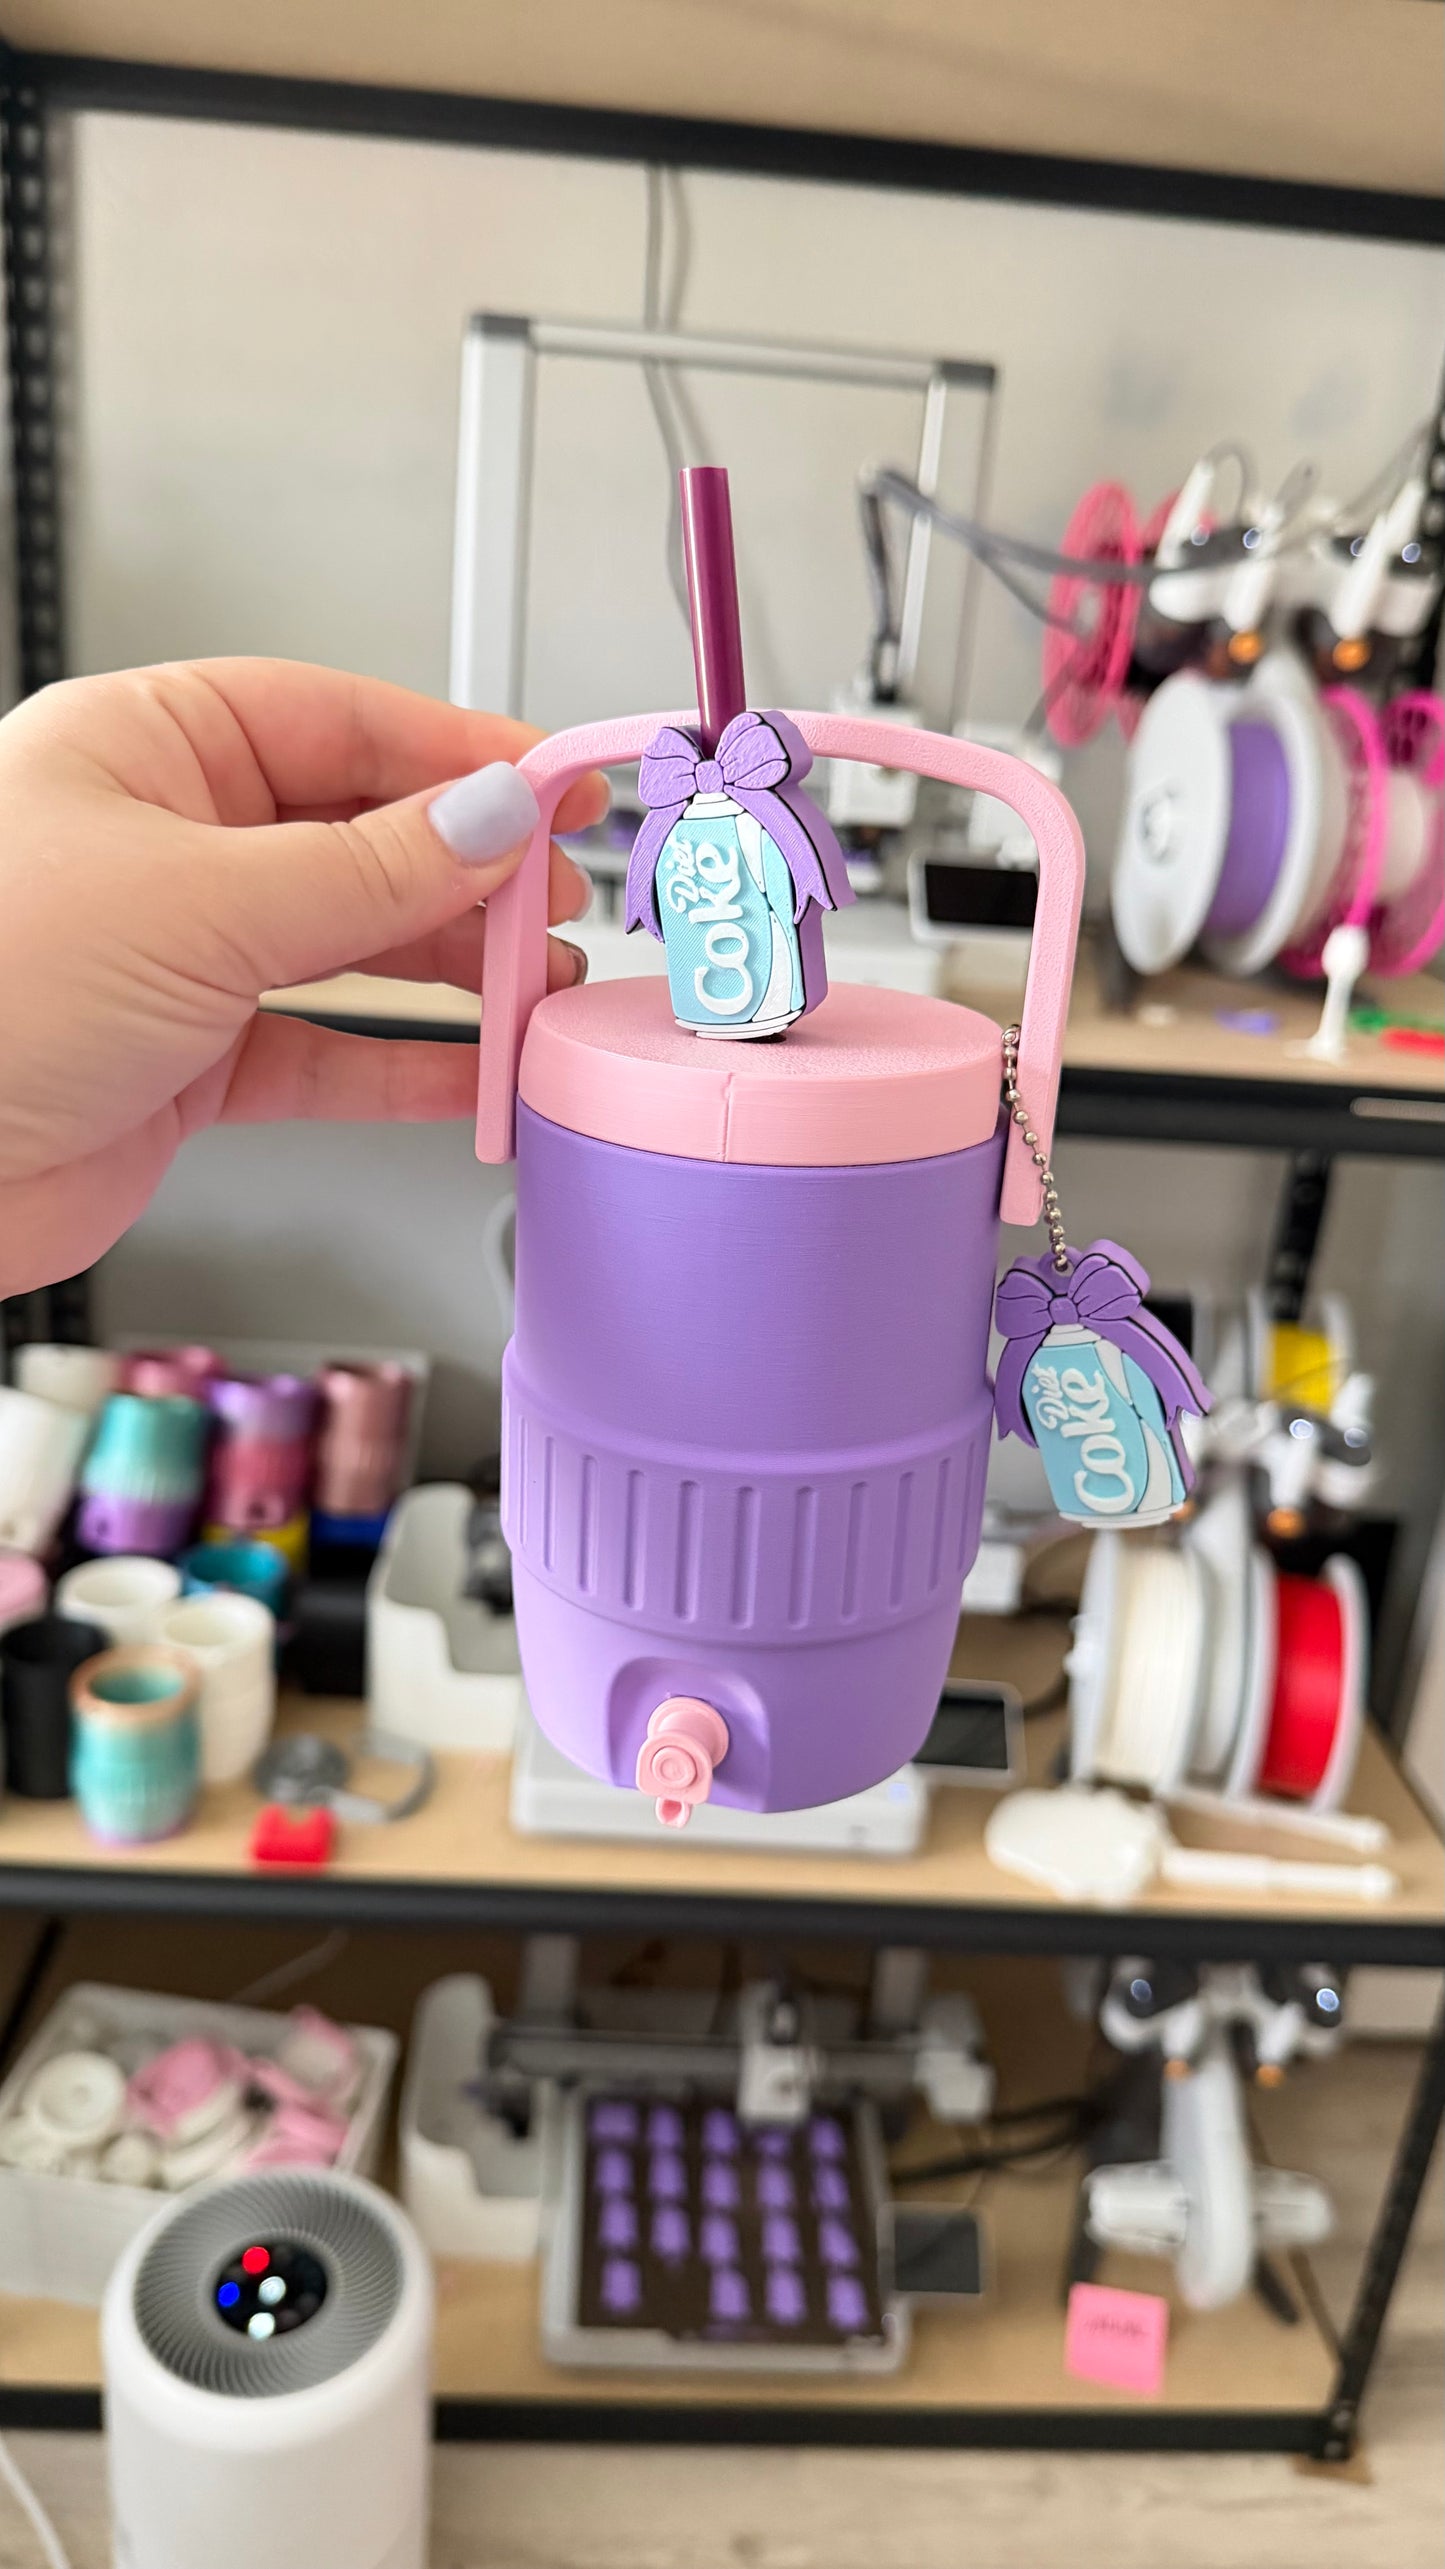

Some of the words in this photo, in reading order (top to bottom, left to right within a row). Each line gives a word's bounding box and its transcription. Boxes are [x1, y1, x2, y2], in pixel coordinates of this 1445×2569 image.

[666, 834, 701, 912] Diet
[688, 842, 754, 1015] Coke
[1031, 1362, 1069, 1430] Diet
[1061, 1367, 1135, 1513] Coke
